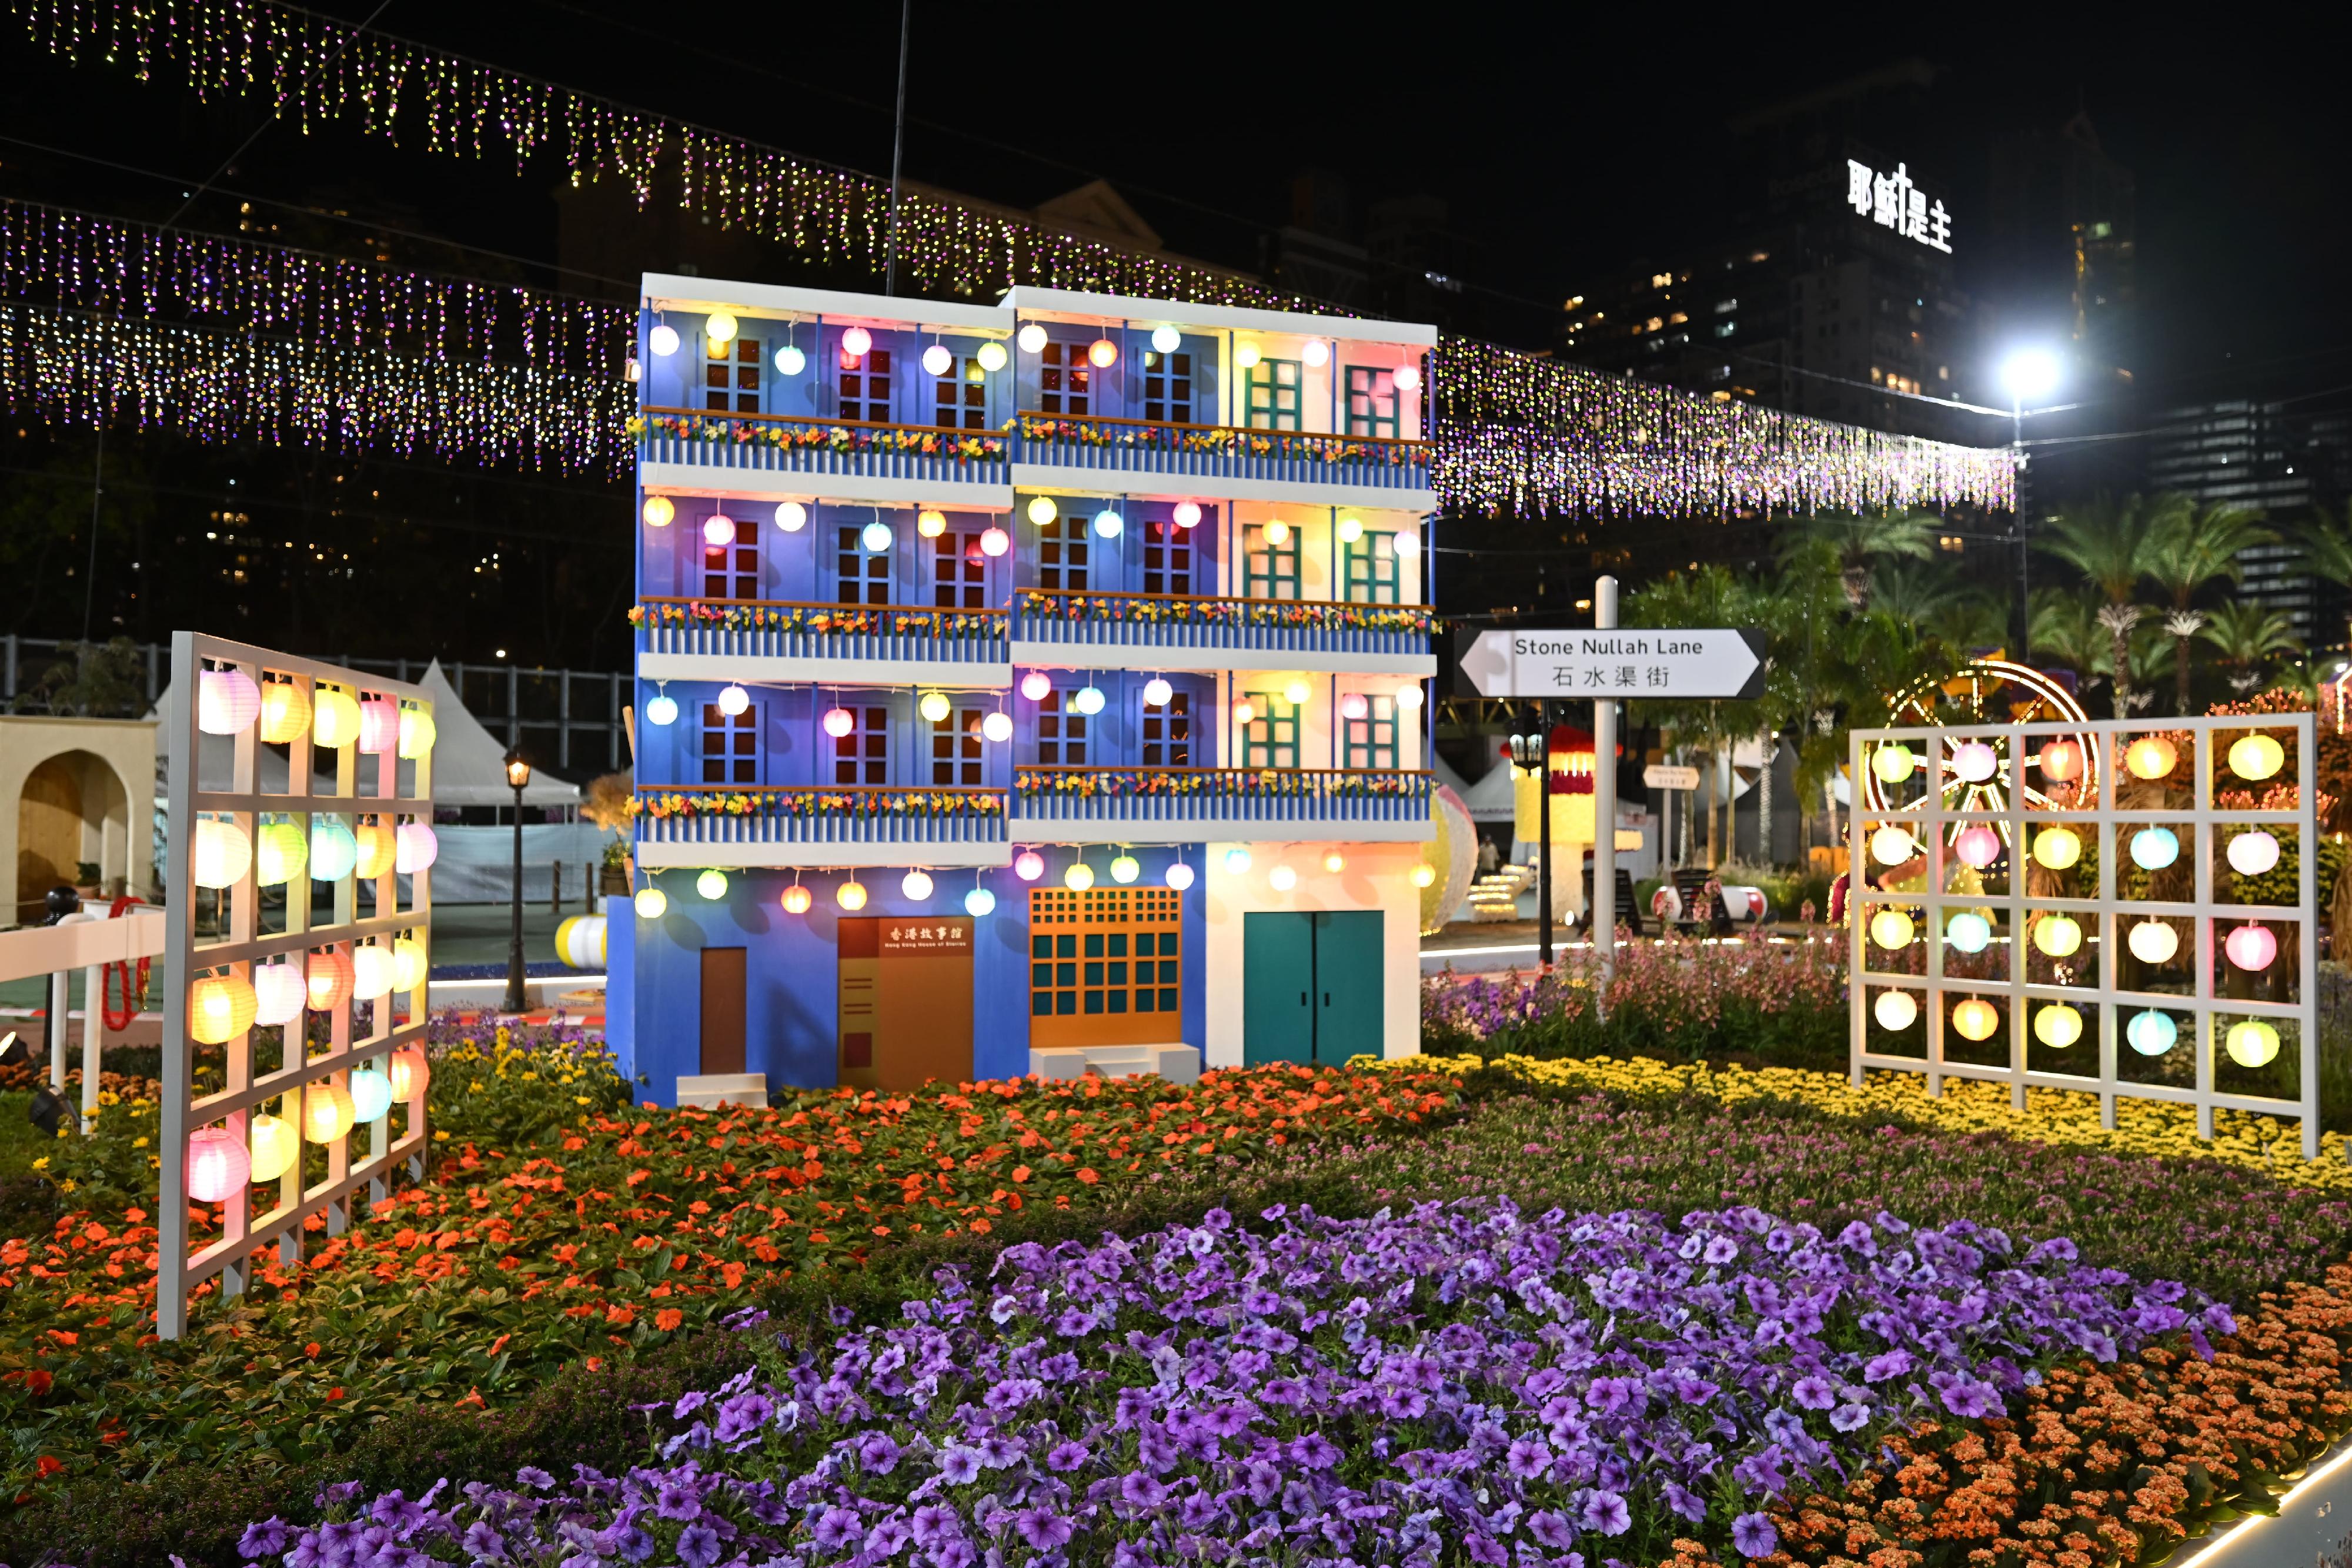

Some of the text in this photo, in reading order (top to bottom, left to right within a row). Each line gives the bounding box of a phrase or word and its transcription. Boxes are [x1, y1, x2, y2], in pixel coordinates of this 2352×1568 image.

[1847, 159, 1953, 254] 耶穌是主
[1515, 638, 1703, 655] Stone Nullah Lane
[1552, 666, 1669, 688] 石水渠街
[890, 926, 963, 941] 香港故事館
